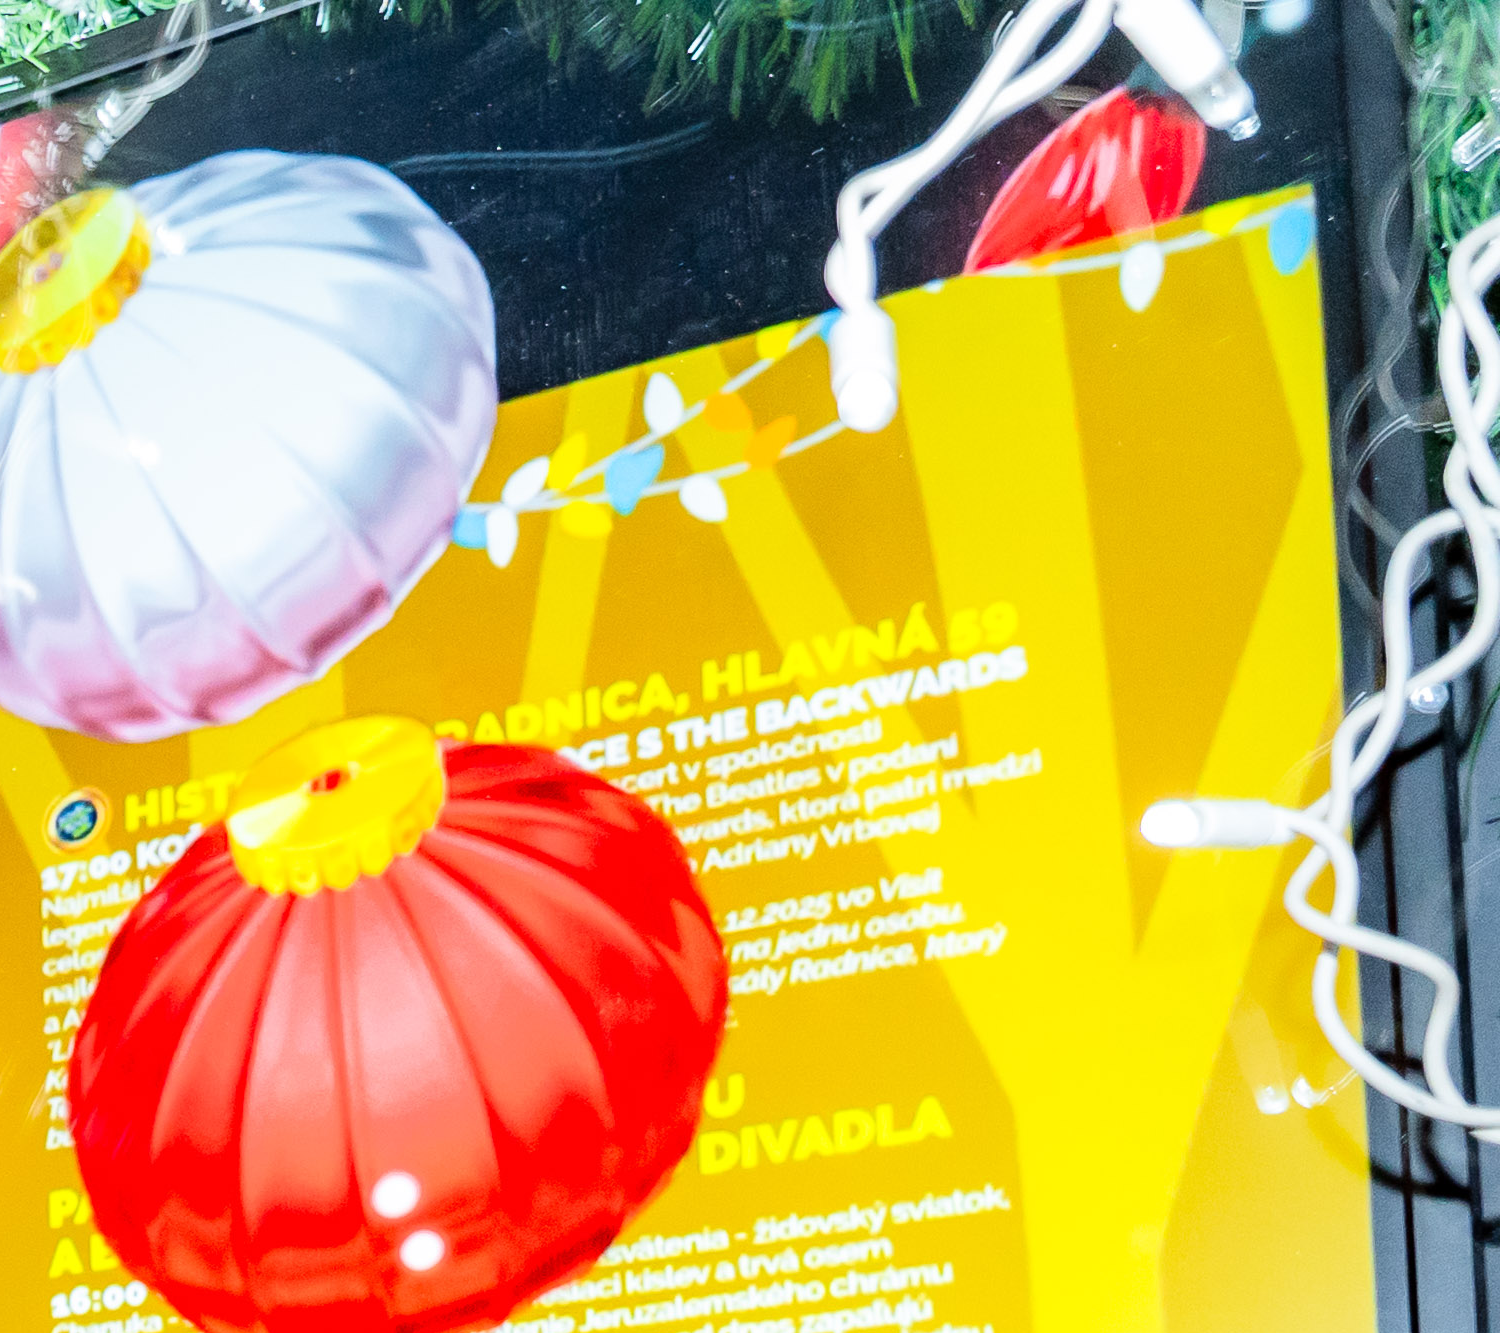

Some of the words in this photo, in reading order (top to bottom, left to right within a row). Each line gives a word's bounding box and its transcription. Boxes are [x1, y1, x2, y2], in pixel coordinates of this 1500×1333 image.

[703, 606, 932, 699] HLAVNÁ
[944, 602, 1020, 664] 59
[637, 727, 663, 760] S
[667, 707, 748, 751] THE
[755, 647, 1028, 733] BACKWARDS
[42, 850, 130, 891] 17:00
[698, 1098, 953, 1175] DIVADLA
[50, 1281, 148, 1318] 16:00
